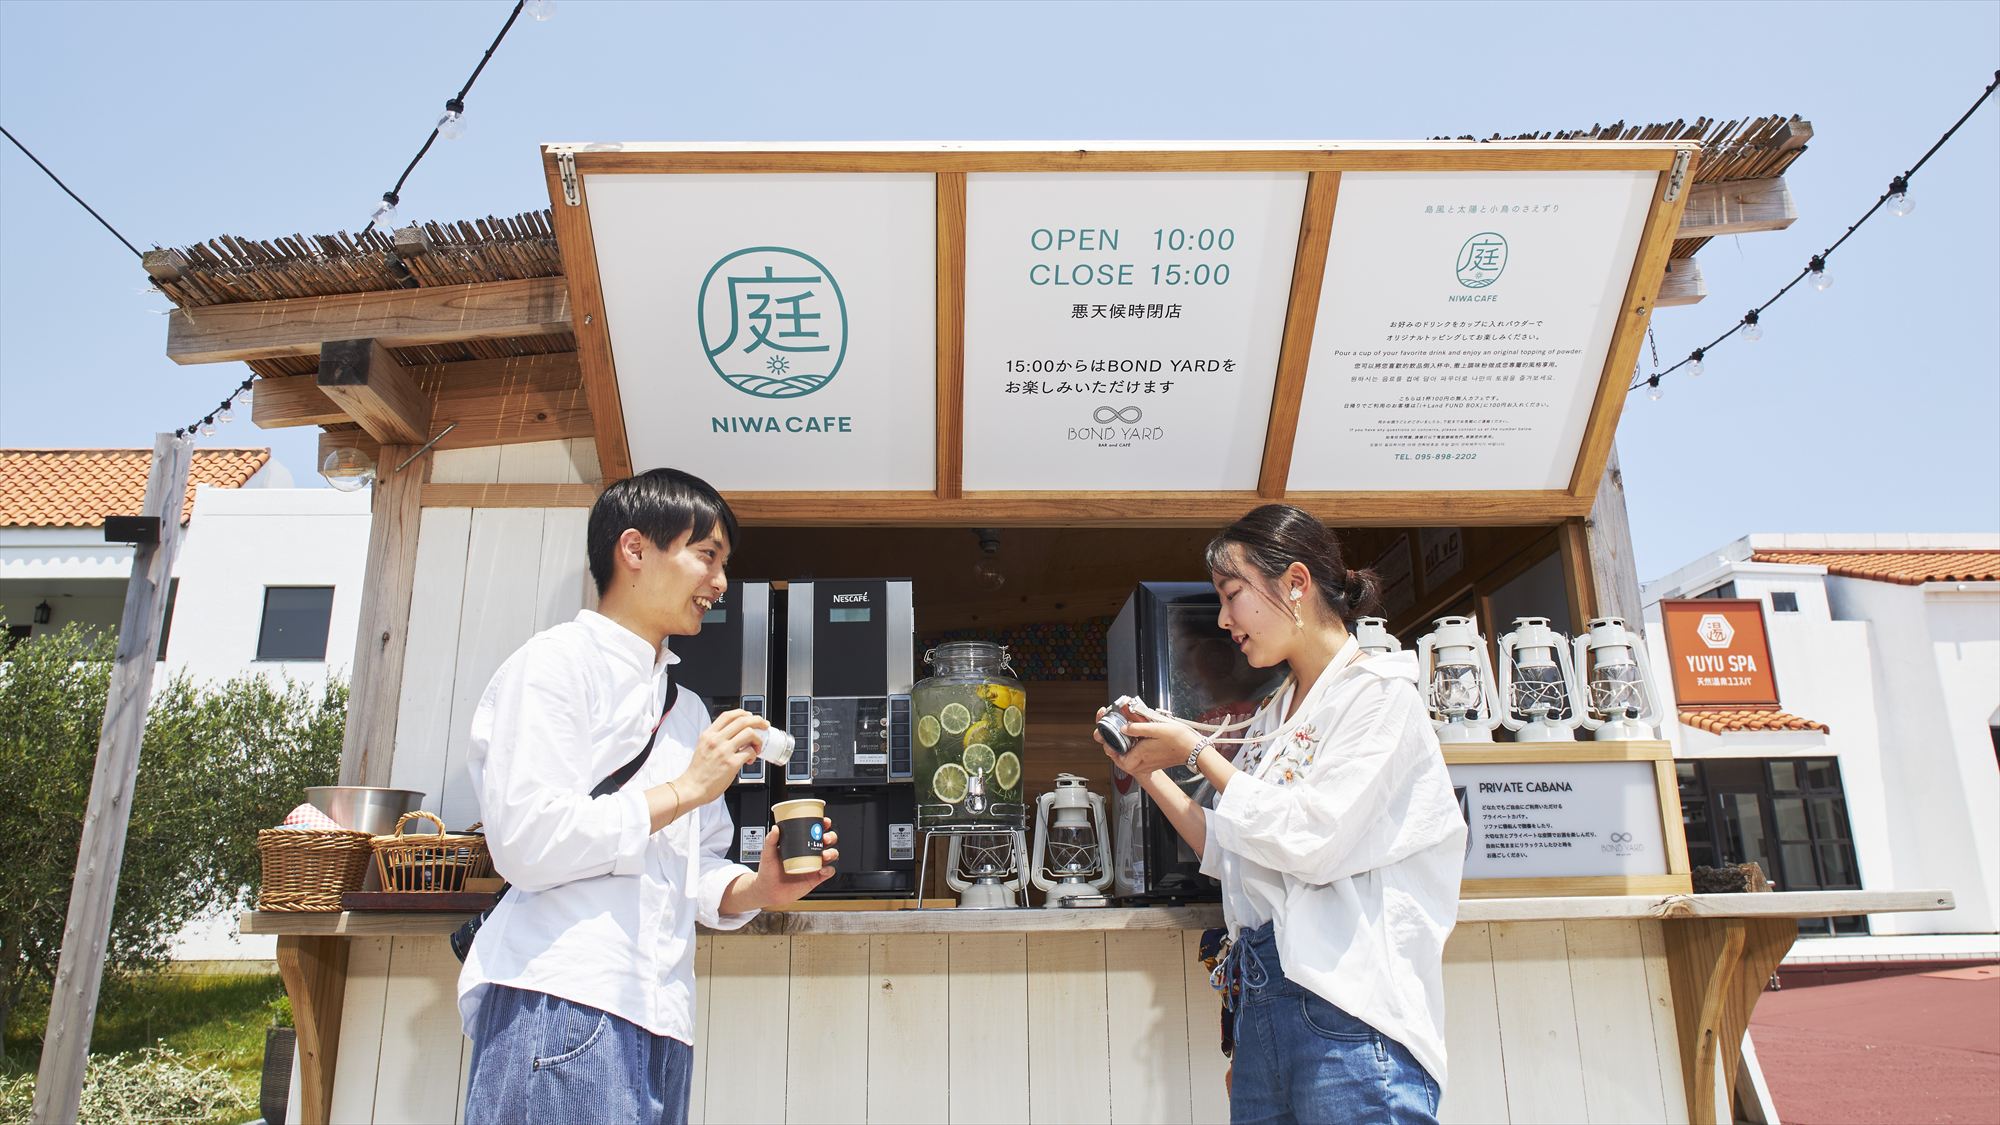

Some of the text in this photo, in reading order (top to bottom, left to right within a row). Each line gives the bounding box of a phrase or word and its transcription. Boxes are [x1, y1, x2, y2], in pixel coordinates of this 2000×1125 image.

[1030, 228, 1236, 251] OPEN 10:00
[1457, 239, 1504, 273] 庭
[1029, 263, 1231, 286] CLOSE 15:00
[1448, 294, 1499, 303] NIWA CAFE
[710, 265, 831, 357] 庭
[1071, 303, 1183, 320] 悪天候時閉店
[1389, 320, 1544, 329] お好みのドリンクをカップに入れパウダーで
[1006, 358, 1237, 373] 15:00からはBOND YARDを
[1004, 380, 1175, 395] お楽しみいただけます
[711, 416, 853, 433] NIWA CAFE
[1067, 426, 1164, 441] BOND YARD
[1414, 453, 1477, 461] 095-898-2202
[1686, 655, 1757, 672] YUYU SPA
[1479, 781, 1573, 794] PRIVATE CABANA
